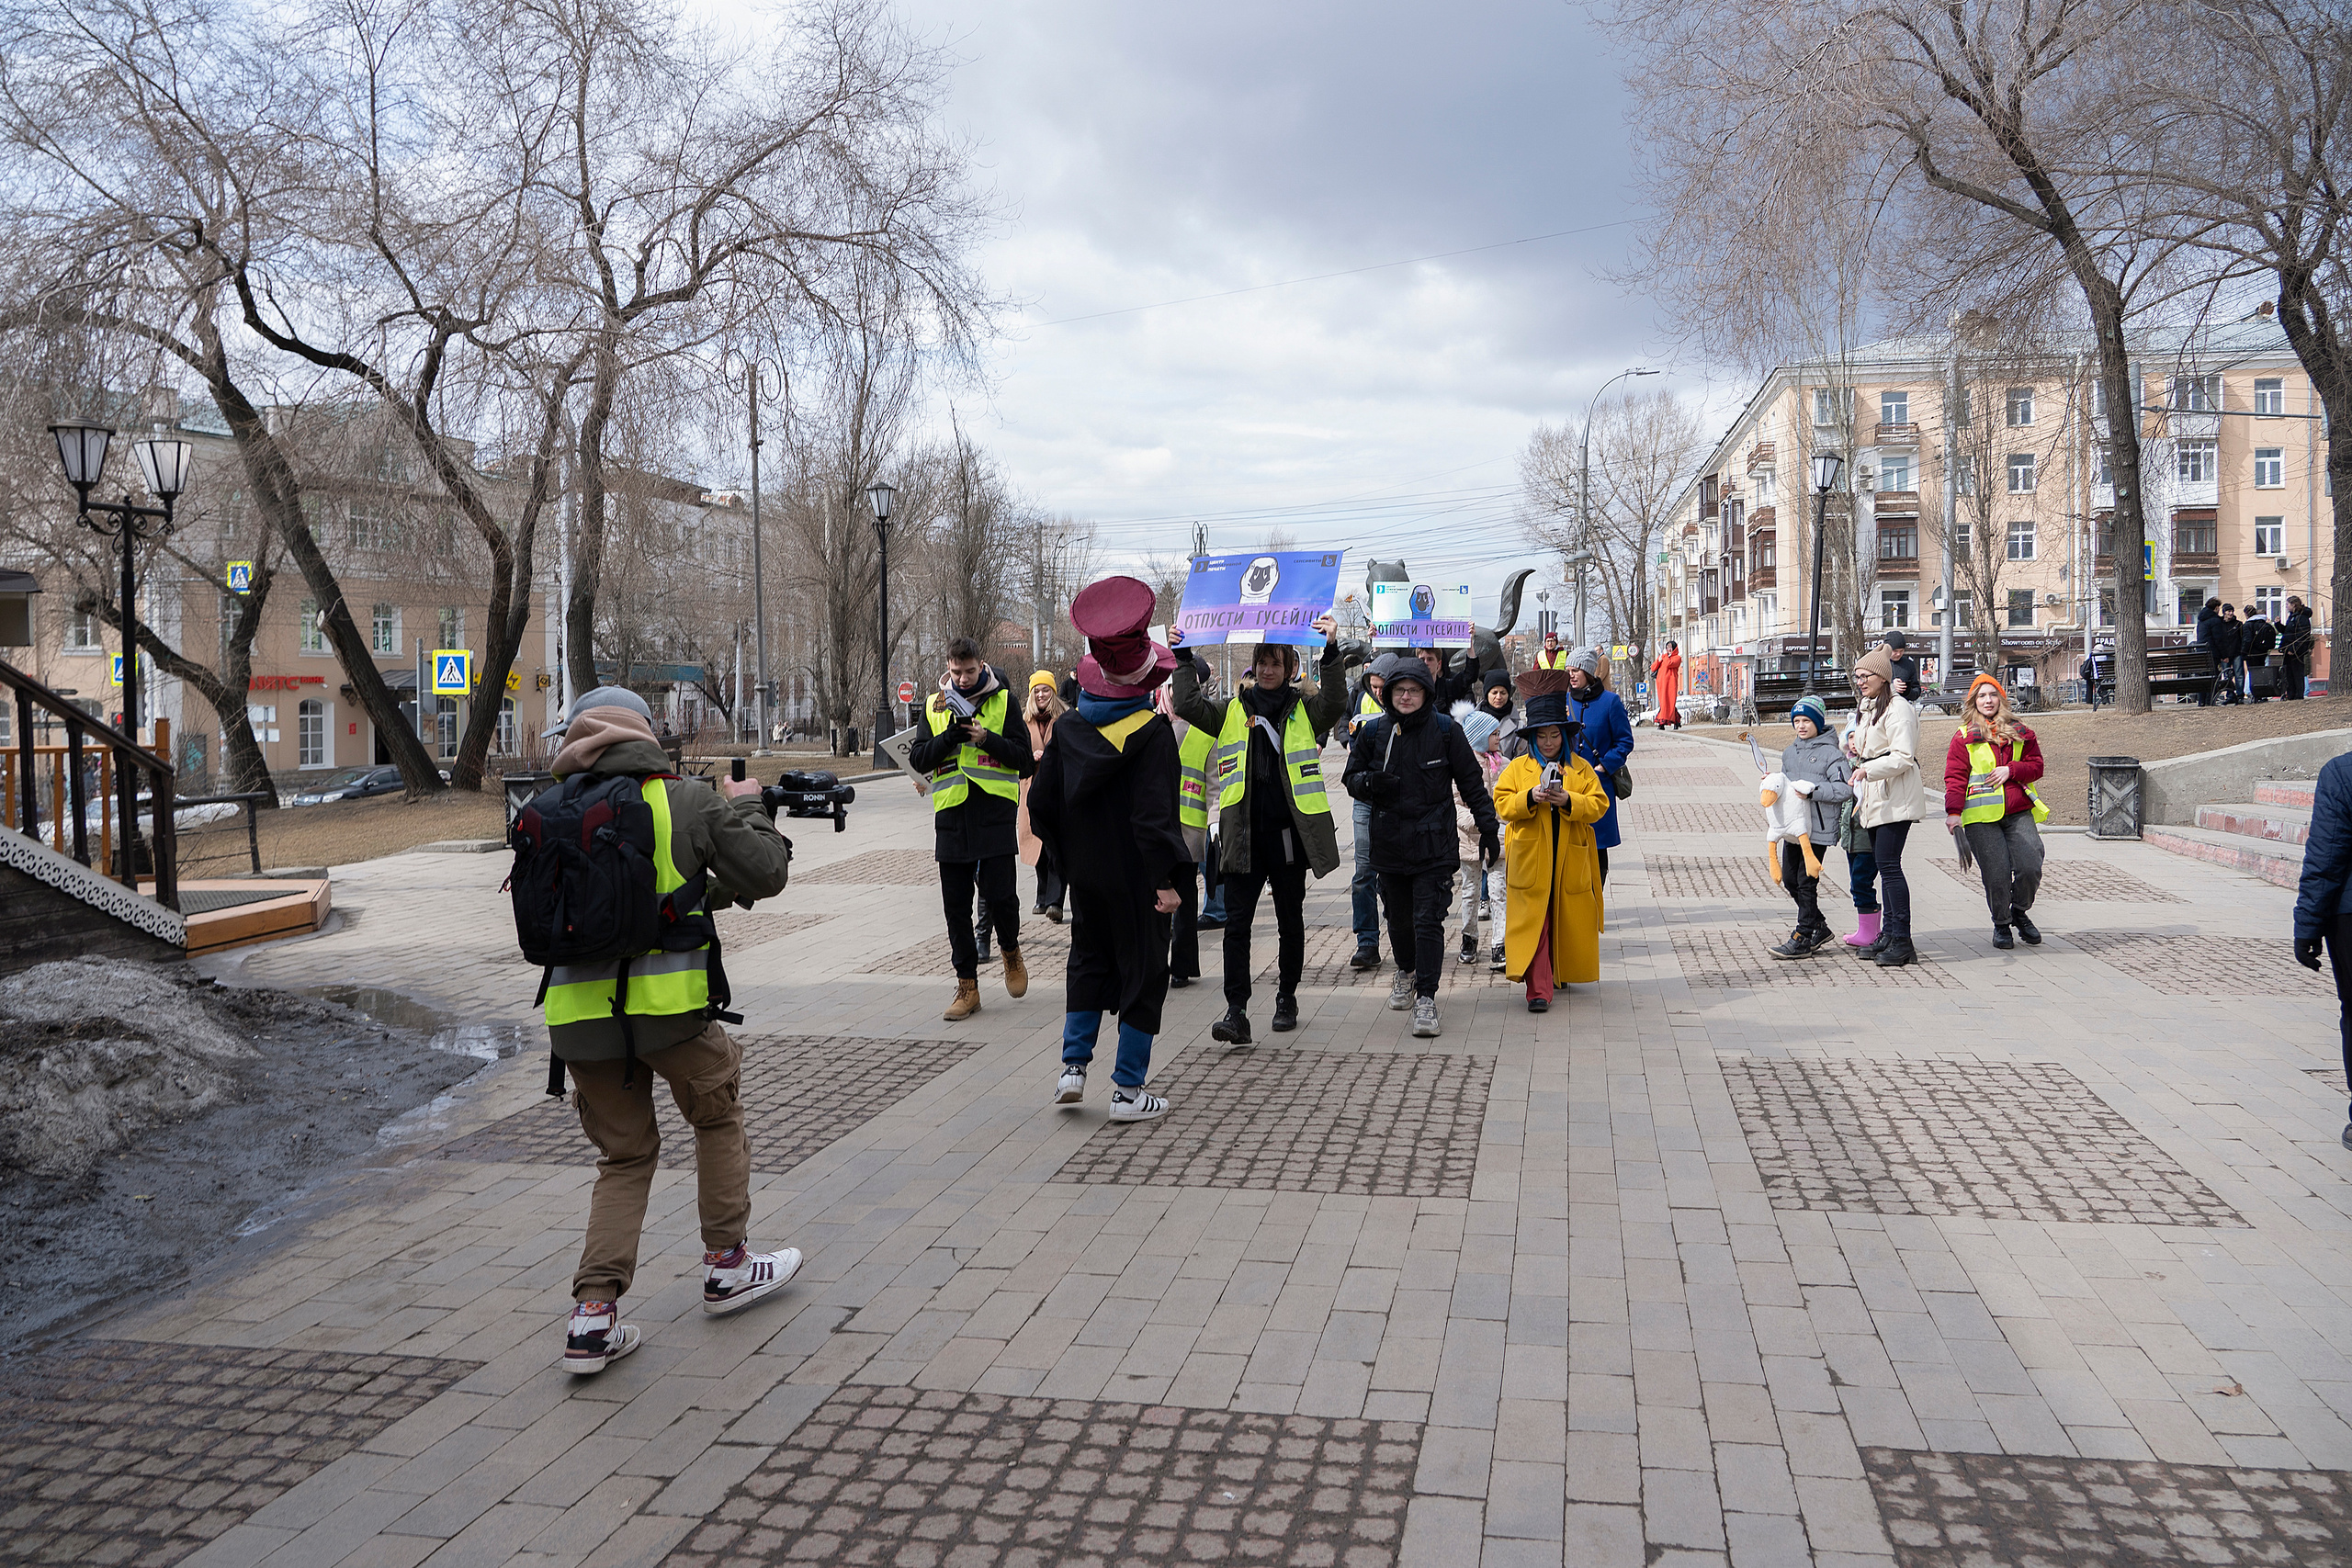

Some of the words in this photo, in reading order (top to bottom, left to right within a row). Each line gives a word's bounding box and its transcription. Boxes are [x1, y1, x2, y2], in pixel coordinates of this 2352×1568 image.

[1184, 611, 1245, 629] ОТПУСТИ
[1378, 624, 1418, 635] ОТПУСТИ
[1426, 623, 1465, 636] ГУСЕЙ!!!
[2095, 637, 2115, 647] БРАД
[257, 676, 300, 690] МТС
[803, 794, 826, 802] RONIN
